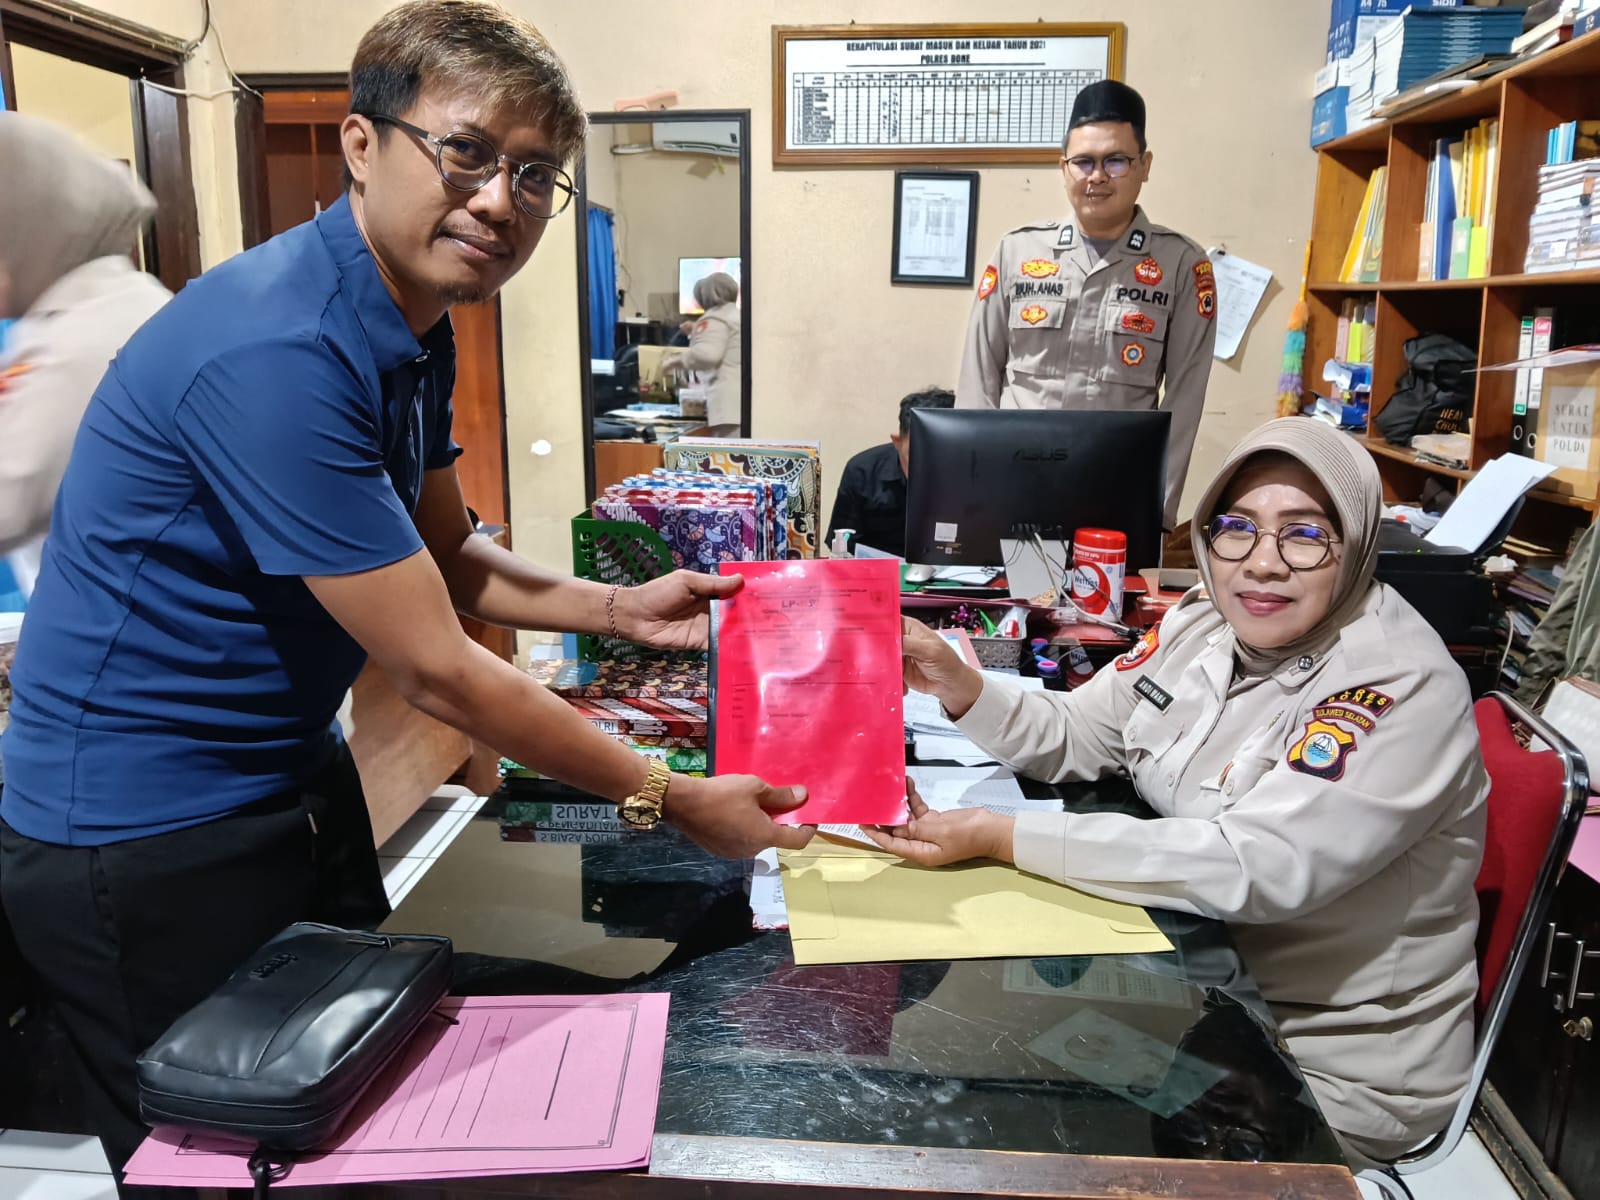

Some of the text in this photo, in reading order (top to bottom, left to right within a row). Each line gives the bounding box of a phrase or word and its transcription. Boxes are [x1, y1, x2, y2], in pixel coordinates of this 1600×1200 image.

[846, 42, 898, 51] REKAPITULASI
[900, 41, 923, 51] SURAT
[926, 41, 953, 50] MASUK
[973, 40, 1002, 50] KELUAR
[1004, 40, 1027, 49] TAHUN
[921, 54, 948, 65] POLRES
[1116, 287, 1169, 306] POLRI
